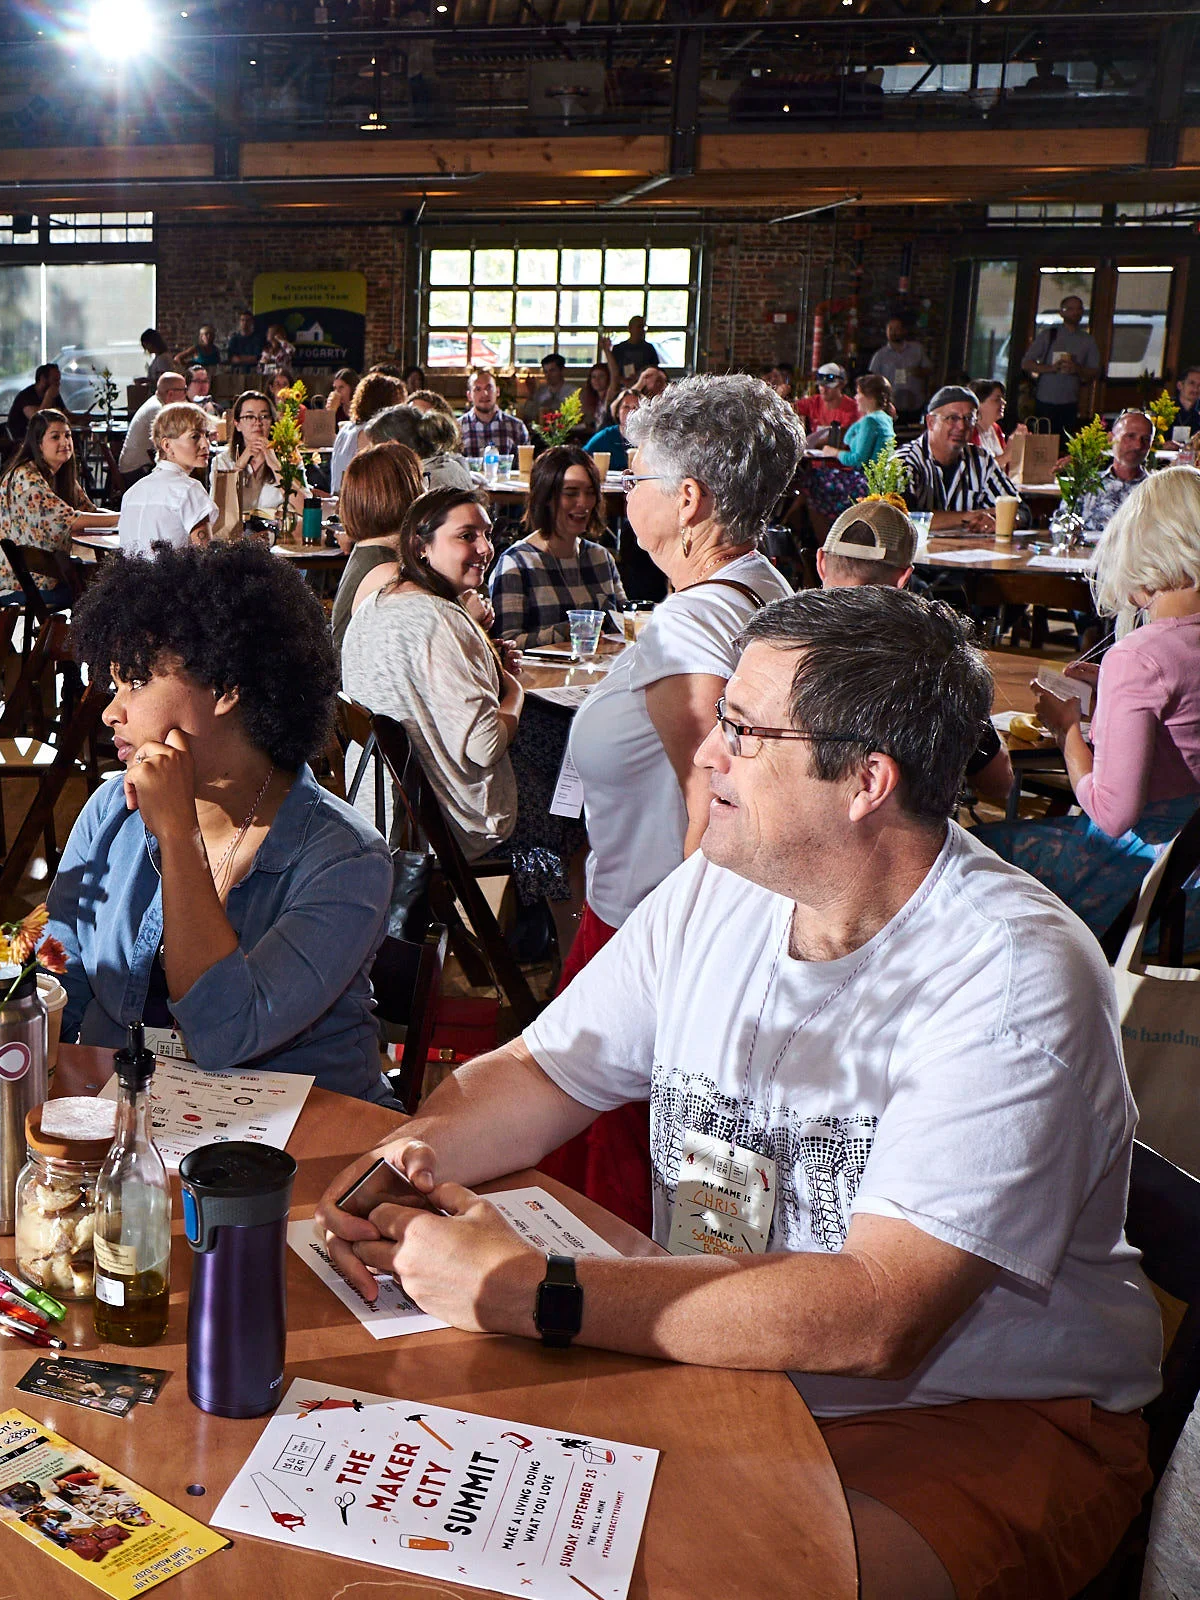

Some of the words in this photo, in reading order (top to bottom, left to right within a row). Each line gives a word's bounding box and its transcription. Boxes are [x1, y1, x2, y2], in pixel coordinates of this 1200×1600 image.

[284, 283, 336, 291] Knoxville's
[299, 348, 348, 358] FOGARTY
[693, 1190, 738, 1215] CHRIS
[702, 1180, 715, 1189] MY
[717, 1186, 741, 1200] NAME
[743, 1194, 751, 1203] IS
[691, 1228, 744, 1254] SOURDOUGH
[704, 1225, 708, 1233] I
[710, 1228, 734, 1243] MAKE
[309, 1243, 333, 1263] SUMMIT
[364, 1299, 380, 1313] THE
[323, 1454, 337, 1471] PRESENTS
[335, 1449, 376, 1485] THE
[366, 1443, 421, 1512] MAKER
[412, 1461, 452, 1508] CITY
[539, 1474, 555, 1496] LOVE
[443, 1450, 500, 1536] SUMMIT
[502, 1526, 519, 1550] MAKE
[514, 1488, 532, 1516] LIVING
[524, 1460, 541, 1486] DOING
[532, 1497, 547, 1515] YOU
[596, 1500, 607, 1514] MINE
[523, 1517, 541, 1542] WHAT
[559, 1533, 580, 1567] SUNDAY,
[571, 1482, 595, 1530] SEPTEMBER
[590, 1522, 601, 1535] MILL
[602, 1490, 625, 1559] #THEMAKERCITYSUMMIT
[587, 1535, 596, 1546] THE
[132, 1568, 153, 1581] 2020
[150, 1558, 172, 1571] SHOW
[169, 1546, 193, 1560] DATES
[133, 1578, 151, 1590] JULY
[161, 1566, 172, 1574] 19
[173, 1558, 187, 1568] OCT
[194, 1547, 208, 1555] 25
